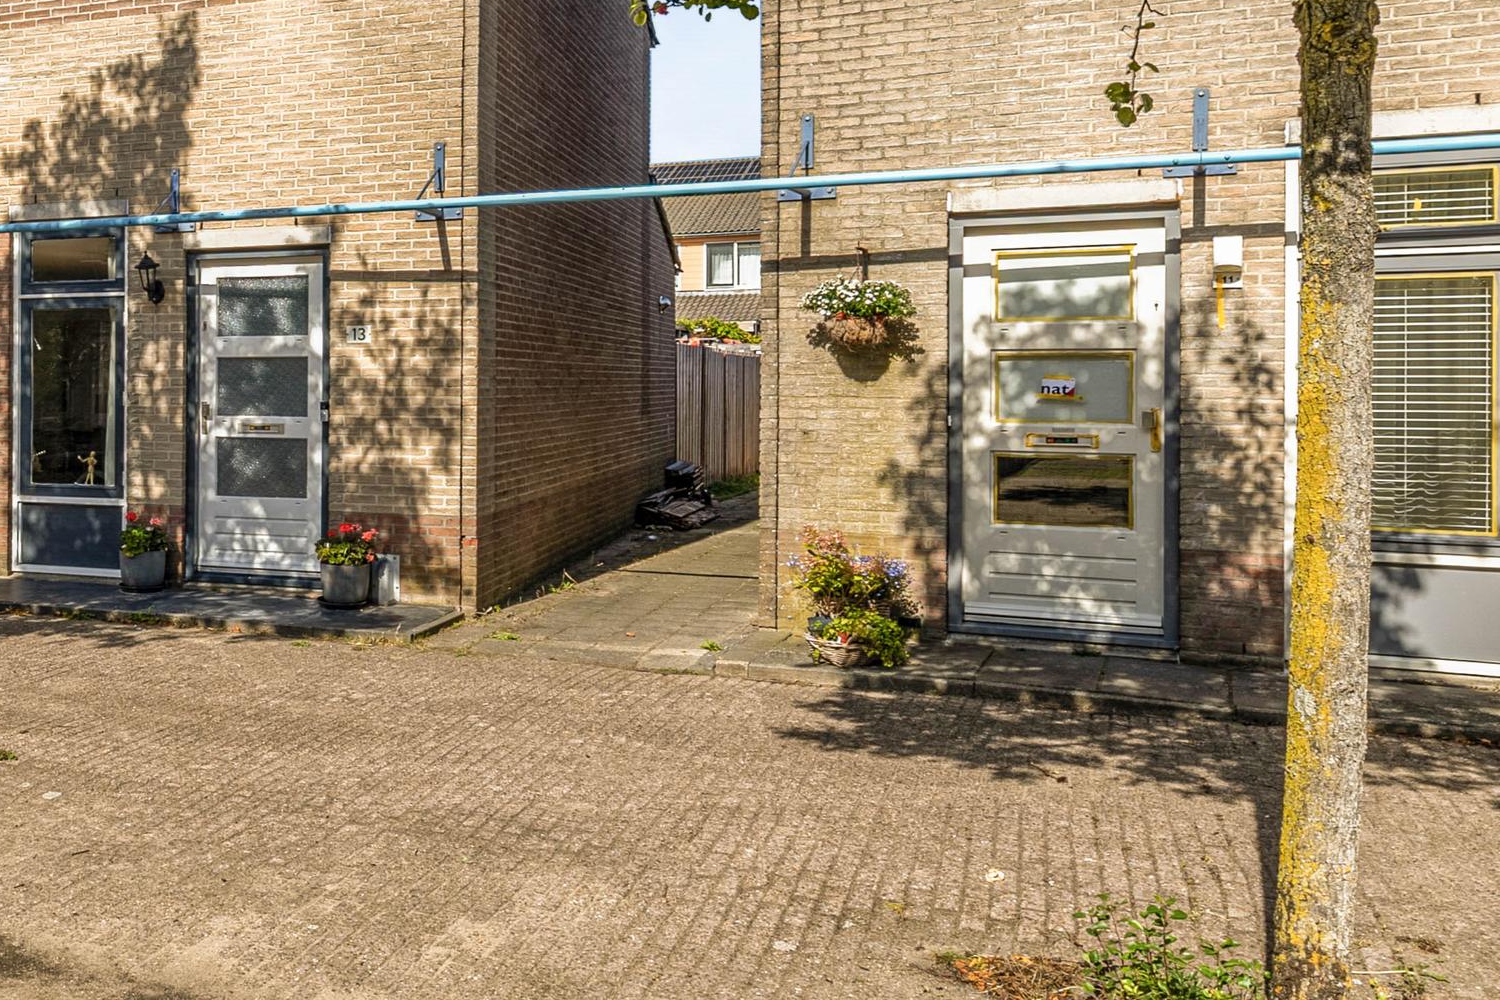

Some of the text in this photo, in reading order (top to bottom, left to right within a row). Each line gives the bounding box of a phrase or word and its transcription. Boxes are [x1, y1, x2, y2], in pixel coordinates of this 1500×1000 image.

[1222, 275, 1234, 284] 11
[352, 327, 366, 341] 13
[1041, 384, 1070, 396] nat
